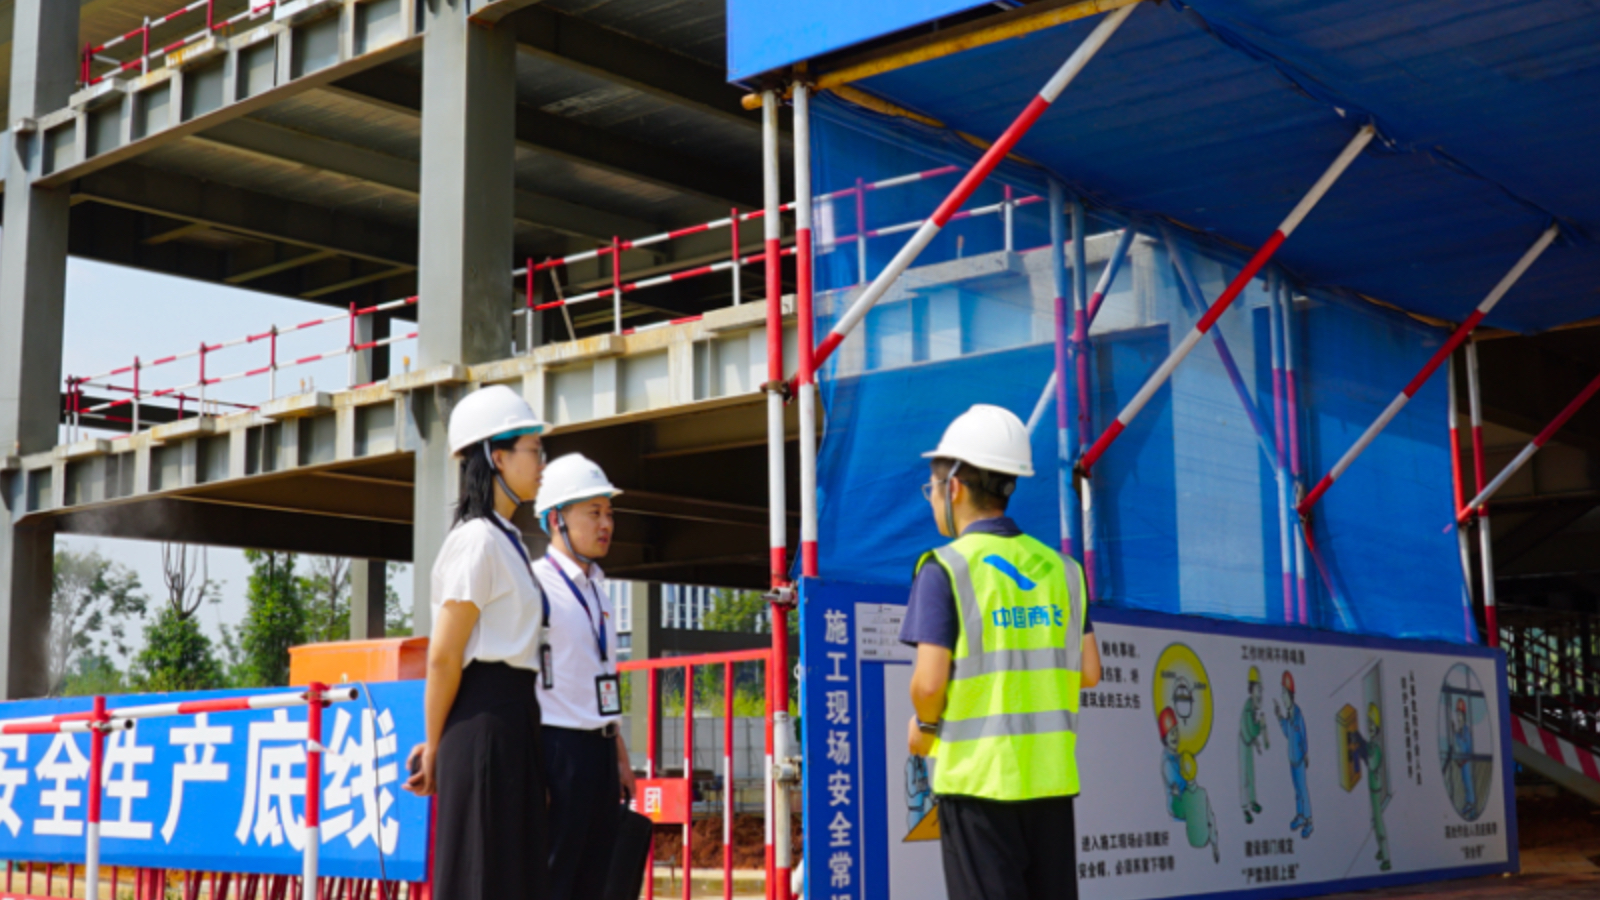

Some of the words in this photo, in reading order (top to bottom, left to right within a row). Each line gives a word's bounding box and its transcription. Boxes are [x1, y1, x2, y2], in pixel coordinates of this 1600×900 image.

[992, 604, 1063, 629] 中国商飞
[824, 608, 852, 900] 施工现场安全常
